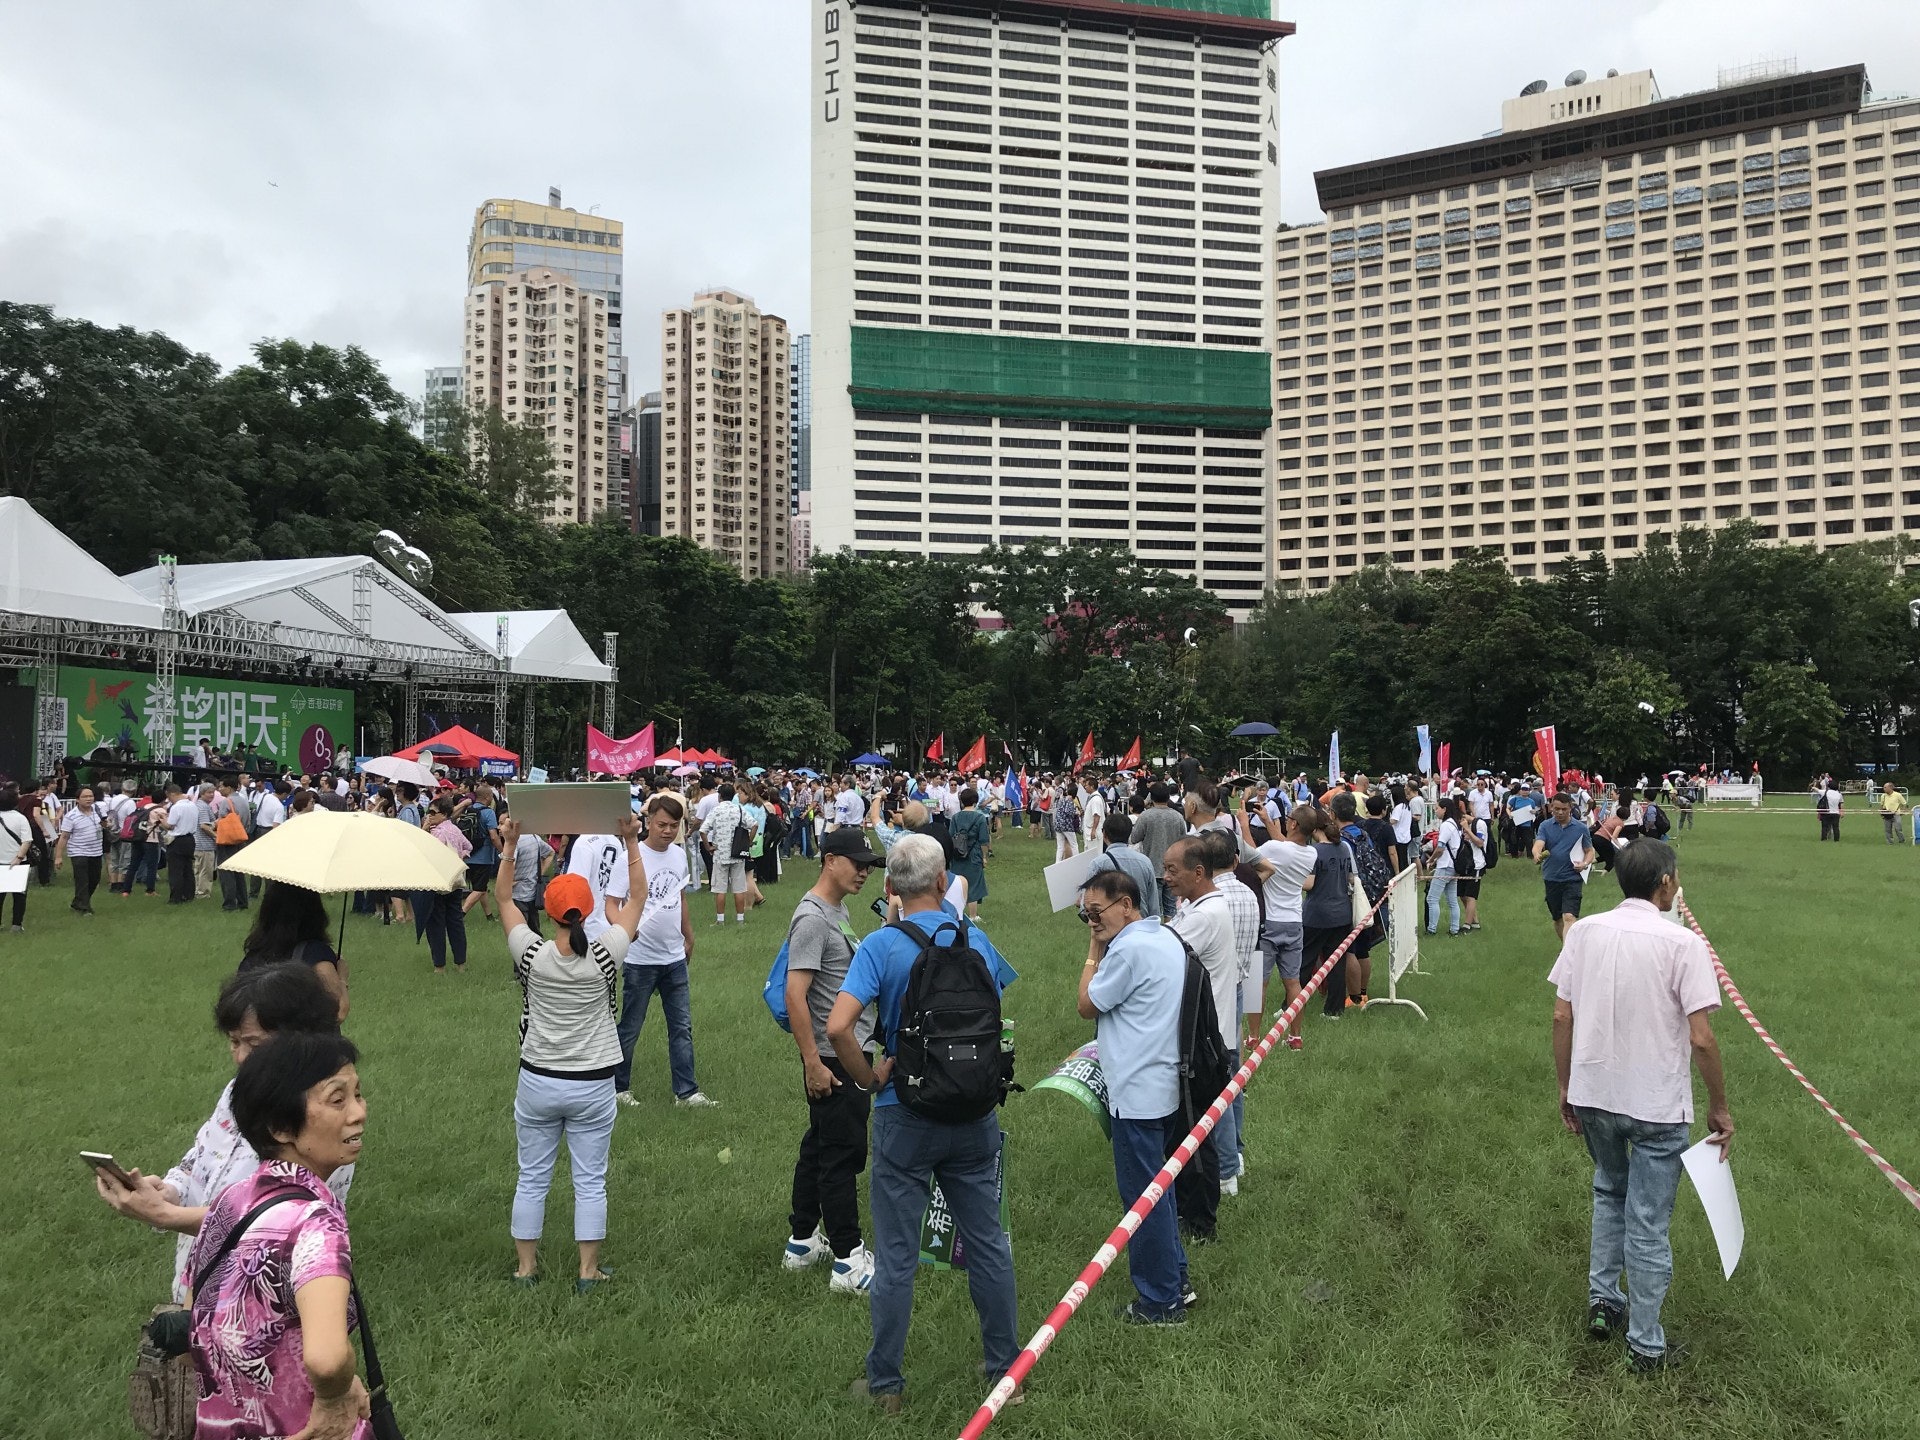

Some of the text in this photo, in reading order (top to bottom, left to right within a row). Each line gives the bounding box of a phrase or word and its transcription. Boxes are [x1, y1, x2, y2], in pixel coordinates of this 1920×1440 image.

[825, 0, 839, 122] CHUB
[143, 683, 279, 757] 希望明天
[315, 727, 325, 758] 8
